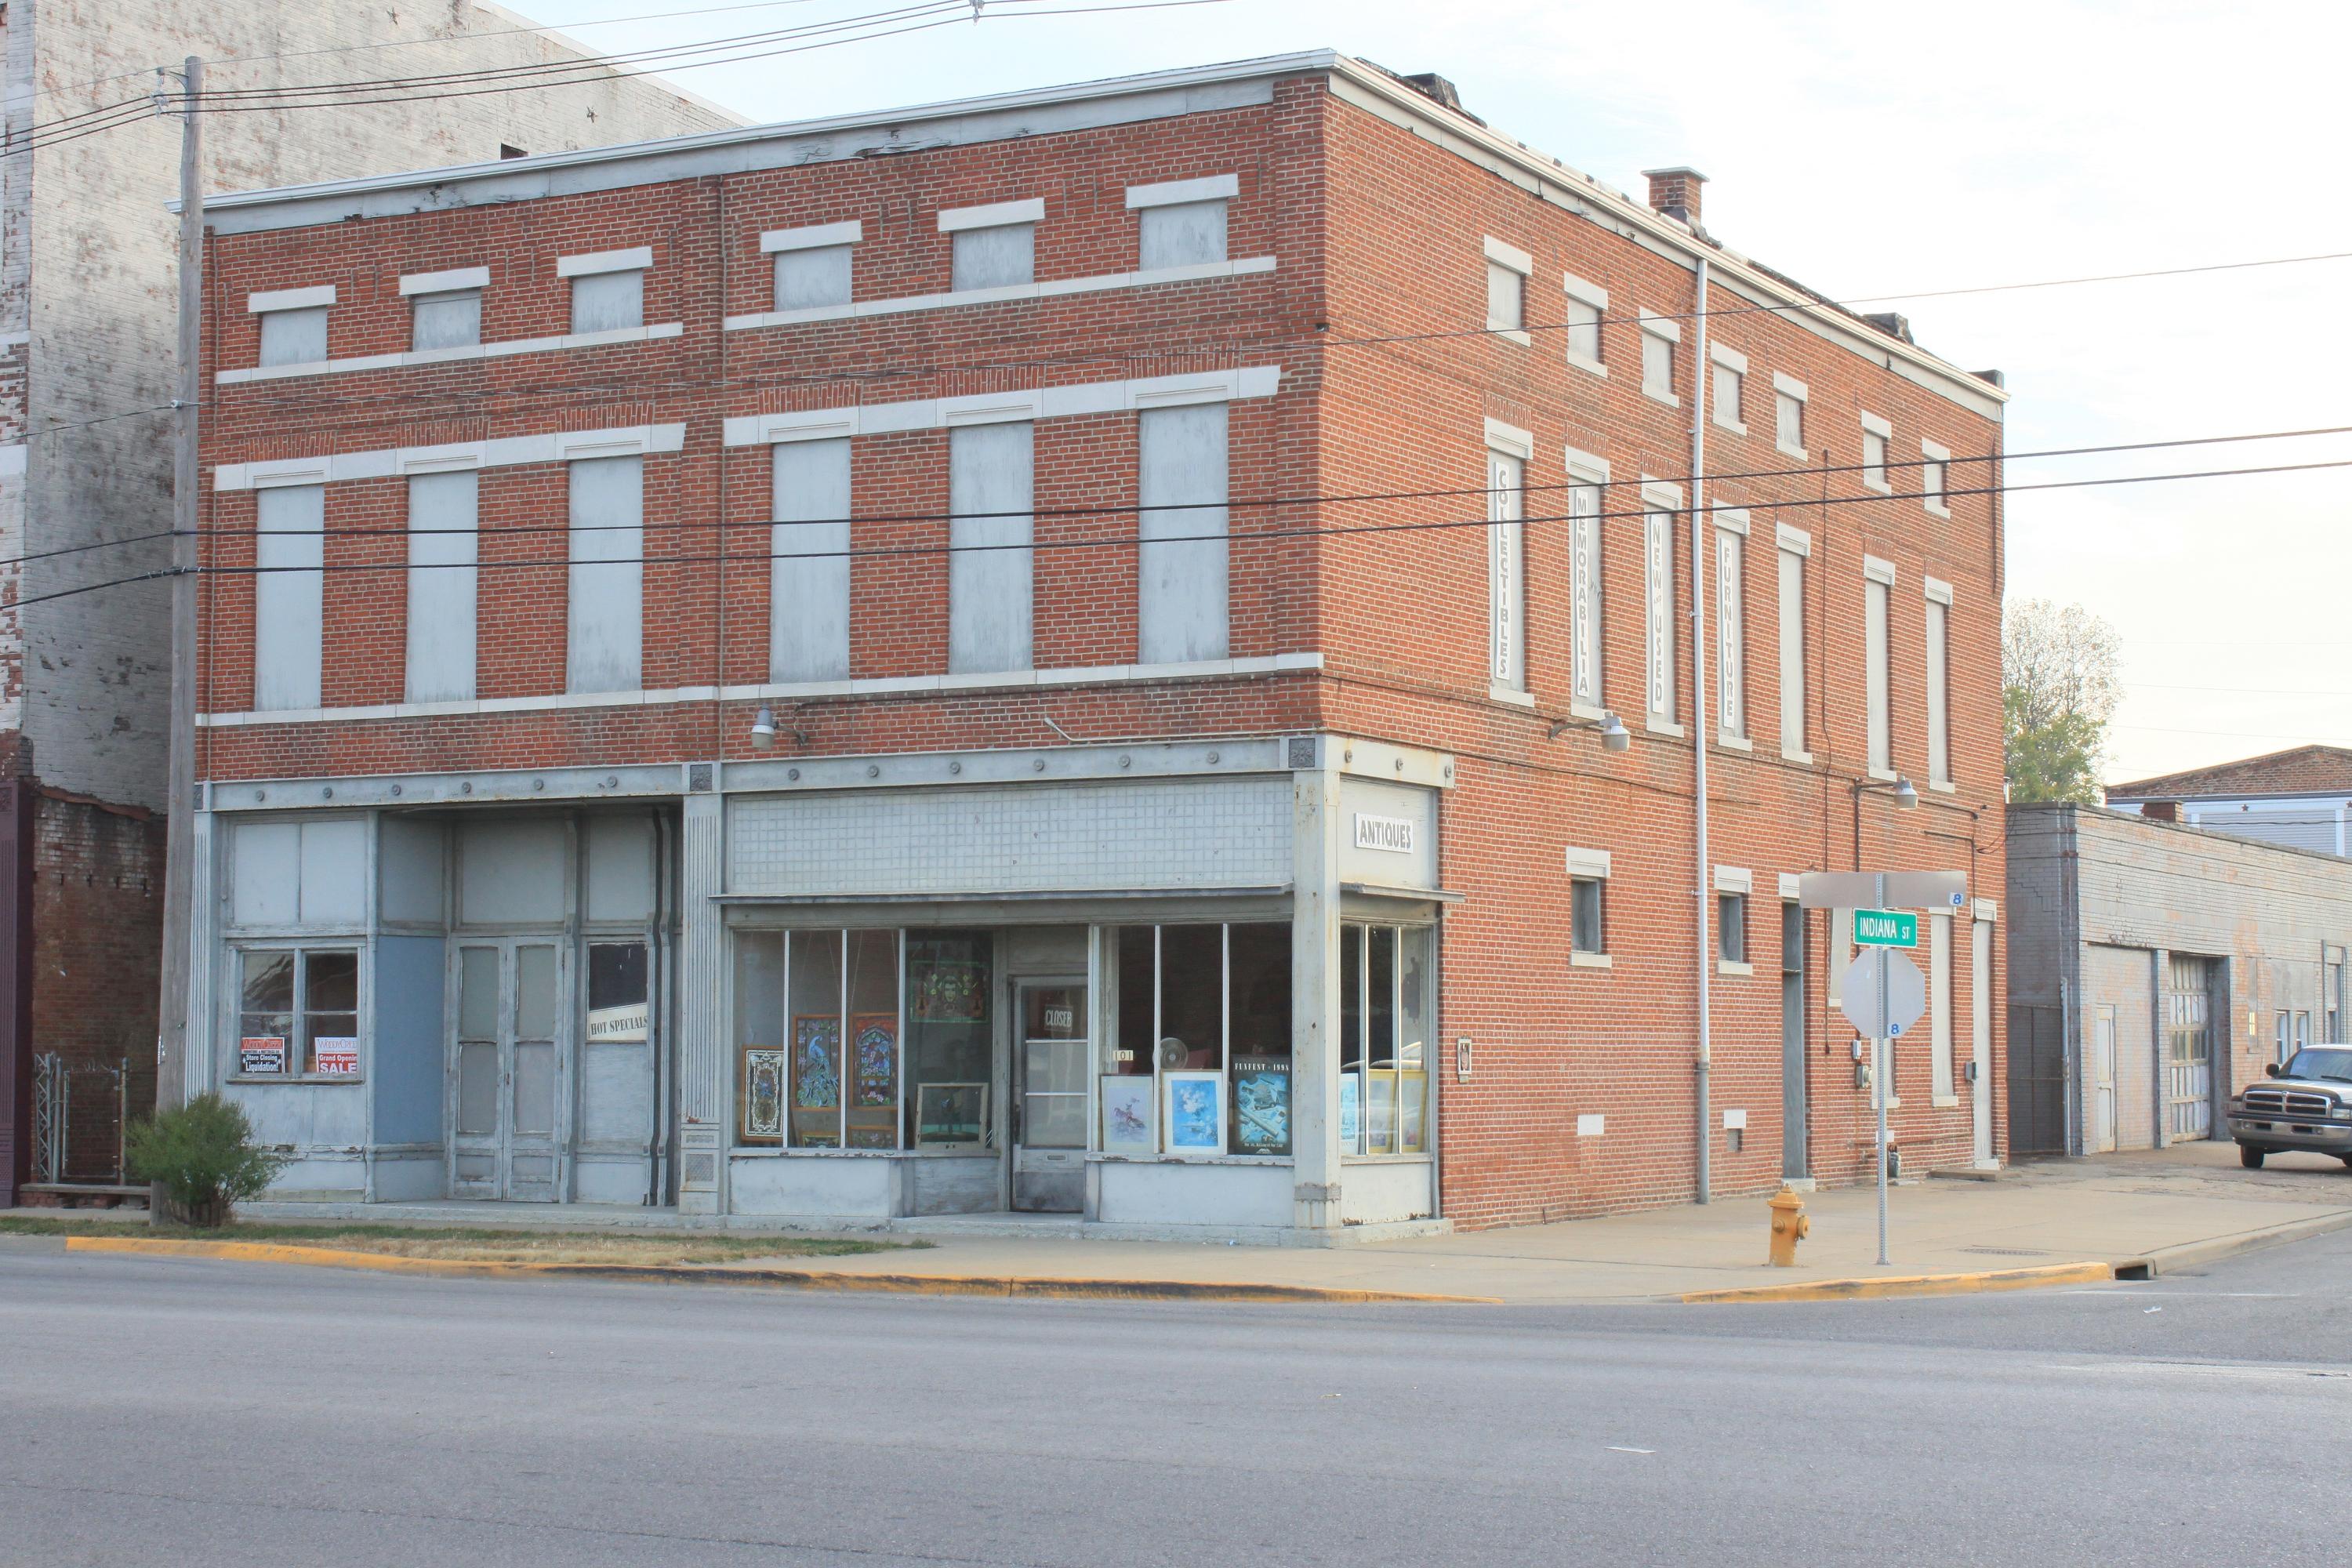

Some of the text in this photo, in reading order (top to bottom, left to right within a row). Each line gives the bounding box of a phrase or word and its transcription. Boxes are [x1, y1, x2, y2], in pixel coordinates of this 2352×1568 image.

[1653, 523, 1662, 589] NEW
[1497, 470, 1508, 674] COLLECTIBLES
[1577, 496, 1588, 691] MEMORABILIA
[1724, 546, 1733, 717] FURNITURE
[1654, 614, 1663, 702] USED
[1359, 819, 1412, 849] ANTIQUES
[1953, 894, 1962, 905] 8
[1860, 916, 1911, 940] INDIANA ST
[591, 1015, 648, 1036] HOT SPECIALS
[1046, 1009, 1073, 1028] CLOSED
[1891, 1023, 1899, 1034] 8
[260, 1054, 278, 1062] Closing
[1115, 1051, 1131, 1060] 101
[245, 1061, 279, 1073] Liquidation!
[320, 1062, 358, 1073] SALE
